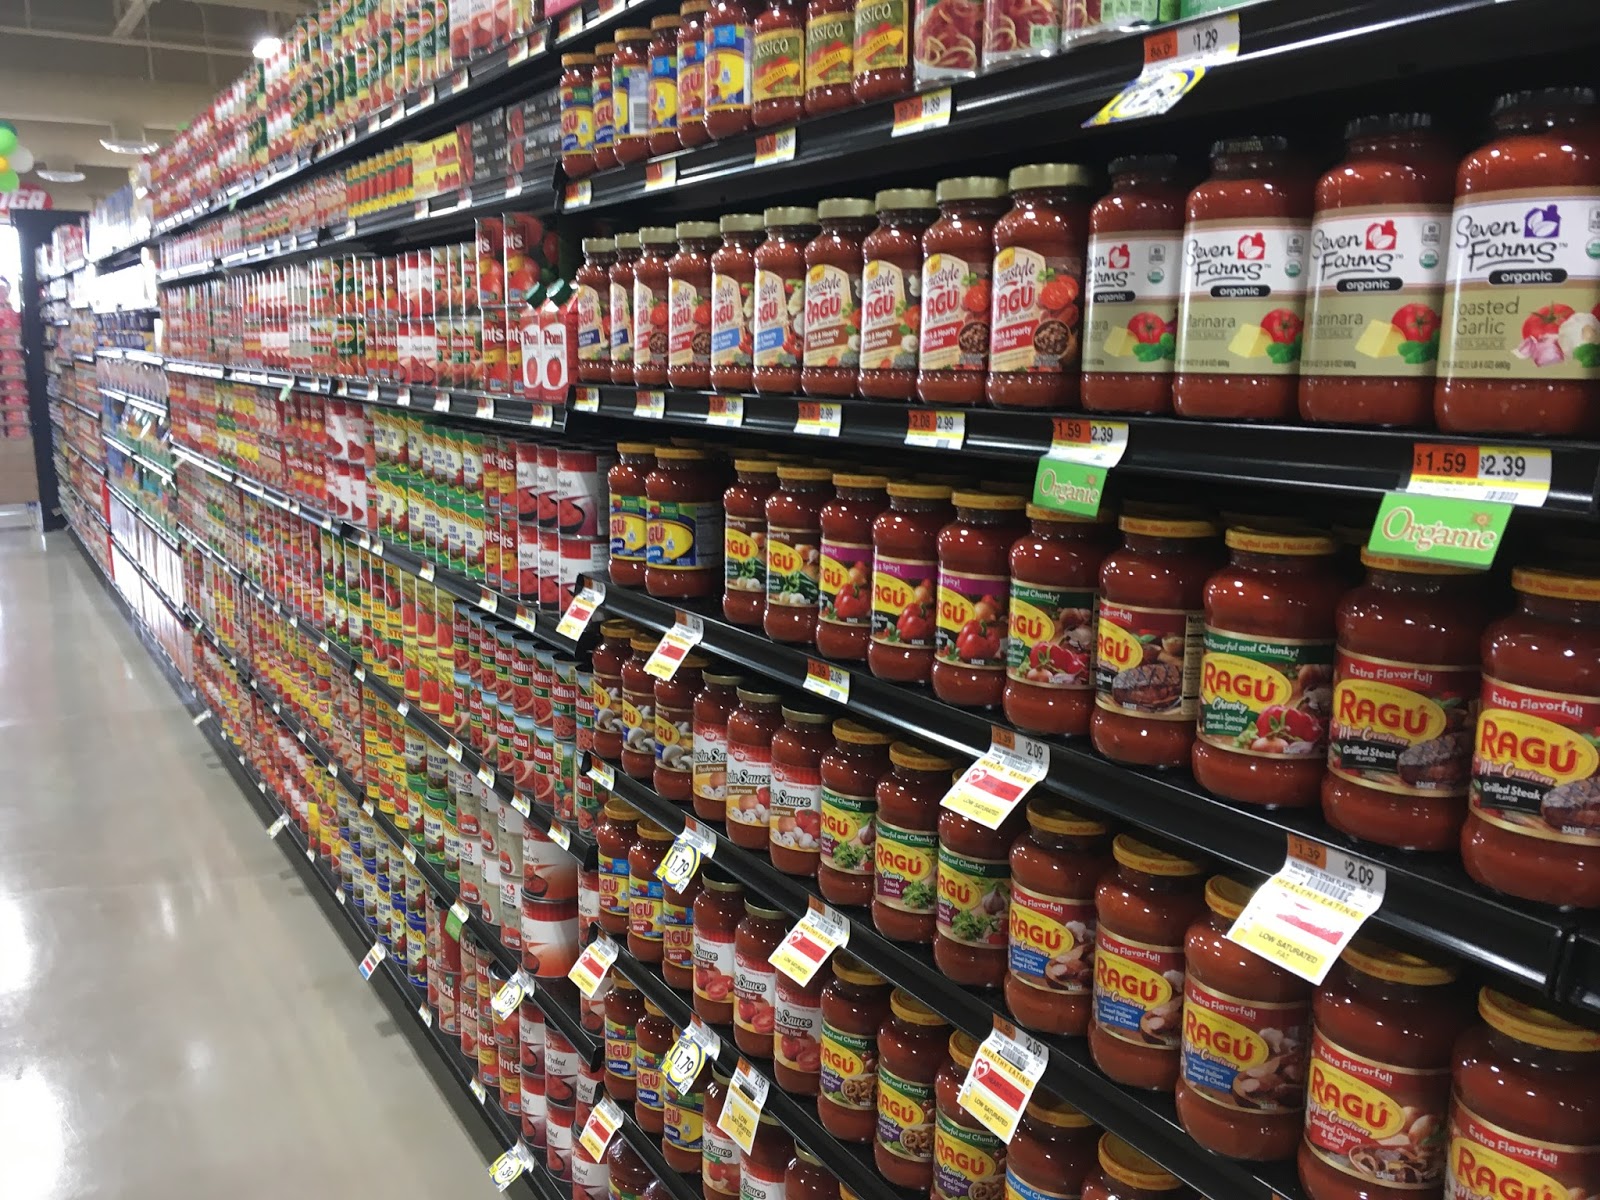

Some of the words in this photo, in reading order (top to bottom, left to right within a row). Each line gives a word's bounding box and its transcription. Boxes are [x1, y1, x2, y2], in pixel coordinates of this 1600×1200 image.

[856, 3, 892, 27] ASSICO
[809, 22, 844, 43] ASSICO
[1312, 229, 1362, 259] Seven
[1456, 215, 1520, 249] Seven
[1186, 239, 1235, 266] Seven
[1468, 239, 1557, 272] Farms
[1088, 270, 1127, 288] arms
[1195, 262, 1262, 286] Farms
[1322, 253, 1393, 281] Farms
[1501, 269, 1552, 284] organic
[1219, 286, 1261, 298] organic
[1346, 278, 1390, 292] organic
[1188, 312, 1236, 328] arinara
[1312, 311, 1364, 326] arinara
[1416, 451, 1467, 473] $1.59
[1481, 454, 1526, 477] $2.39
[1039, 468, 1099, 505] Organic
[1383, 506, 1497, 550] Organic
[727, 540, 751, 558] AGÚ
[875, 585, 906, 608] AGÚ
[938, 600, 966, 624] AGÚ
[1010, 611, 1042, 639] AGÚ
[1099, 633, 1131, 663] AGÚ
[1239, 642, 1257, 652] and
[1258, 643, 1300, 658] Chunky!
[1203, 662, 1275, 702] RAGÚ
[1350, 663, 1374, 680] Extra
[1377, 669, 1433, 685] Flavorful!
[1212, 696, 1248, 714] Chunky
[1339, 688, 1428, 735] RAGÚ
[1492, 691, 1518, 709] Extra
[1520, 698, 1583, 718] Flavorful!
[709, 748, 727, 763] Sau
[1343, 744, 1369, 756] Grilled
[1370, 748, 1397, 760] Steak
[1481, 719, 1577, 773] RAGÚ
[779, 790, 811, 807] Sauce
[1482, 782, 1510, 795] Grilled
[1511, 785, 1540, 800] Steak
[822, 811, 849, 836] AGÚ
[909, 833, 937, 845] Chunky!
[876, 843, 922, 874] RAGÚ
[1345, 859, 1374, 887] $2.09
[939, 875, 970, 905] AGÚ
[1028, 899, 1063, 914] Flavorful!
[1321, 897, 1359, 917] EATING
[1010, 909, 1062, 950] RAGÚ
[695, 943, 718, 961] Sauce
[1102, 937, 1119, 954] Extra
[1120, 946, 1161, 963] Flavorful!
[1258, 930, 1276, 943] LOW
[1277, 938, 1318, 964] SATURATED
[740, 974, 767, 992] Sauce
[1097, 956, 1158, 1002] RAGÚ
[1192, 988, 1209, 1007] Extra
[1210, 1000, 1257, 1020] Flavorful!
[782, 1009, 813, 1028] Sauce
[1186, 1009, 1253, 1063] RAGÚ
[821, 1046, 854, 1075] AGÚ
[983, 1047, 1008, 1069] HEALTHY
[1007, 1066, 1030, 1087] EATING
[1320, 1046, 1340, 1067] Extra
[1342, 1060, 1393, 1084] Flavorful!
[879, 1088, 915, 1123] AGÚ
[1312, 1066, 1388, 1129] RAGÚ
[737, 1112, 748, 1124] LOW
[974, 1097, 984, 1108] LOW
[983, 1102, 1008, 1127] SATURATED
[707, 1138, 733, 1159] Sauce
[1327, 1132, 1346, 1147] Beef
[1336, 1128, 1361, 1144] Onion
[1468, 1124, 1495, 1149] Extra
[1498, 1140, 1558, 1165] Flavorful!
[937, 1134, 985, 1175] RAGÚ
[942, 1163, 966, 1181] Chunky
[742, 1179, 767, 1200] Sauce
